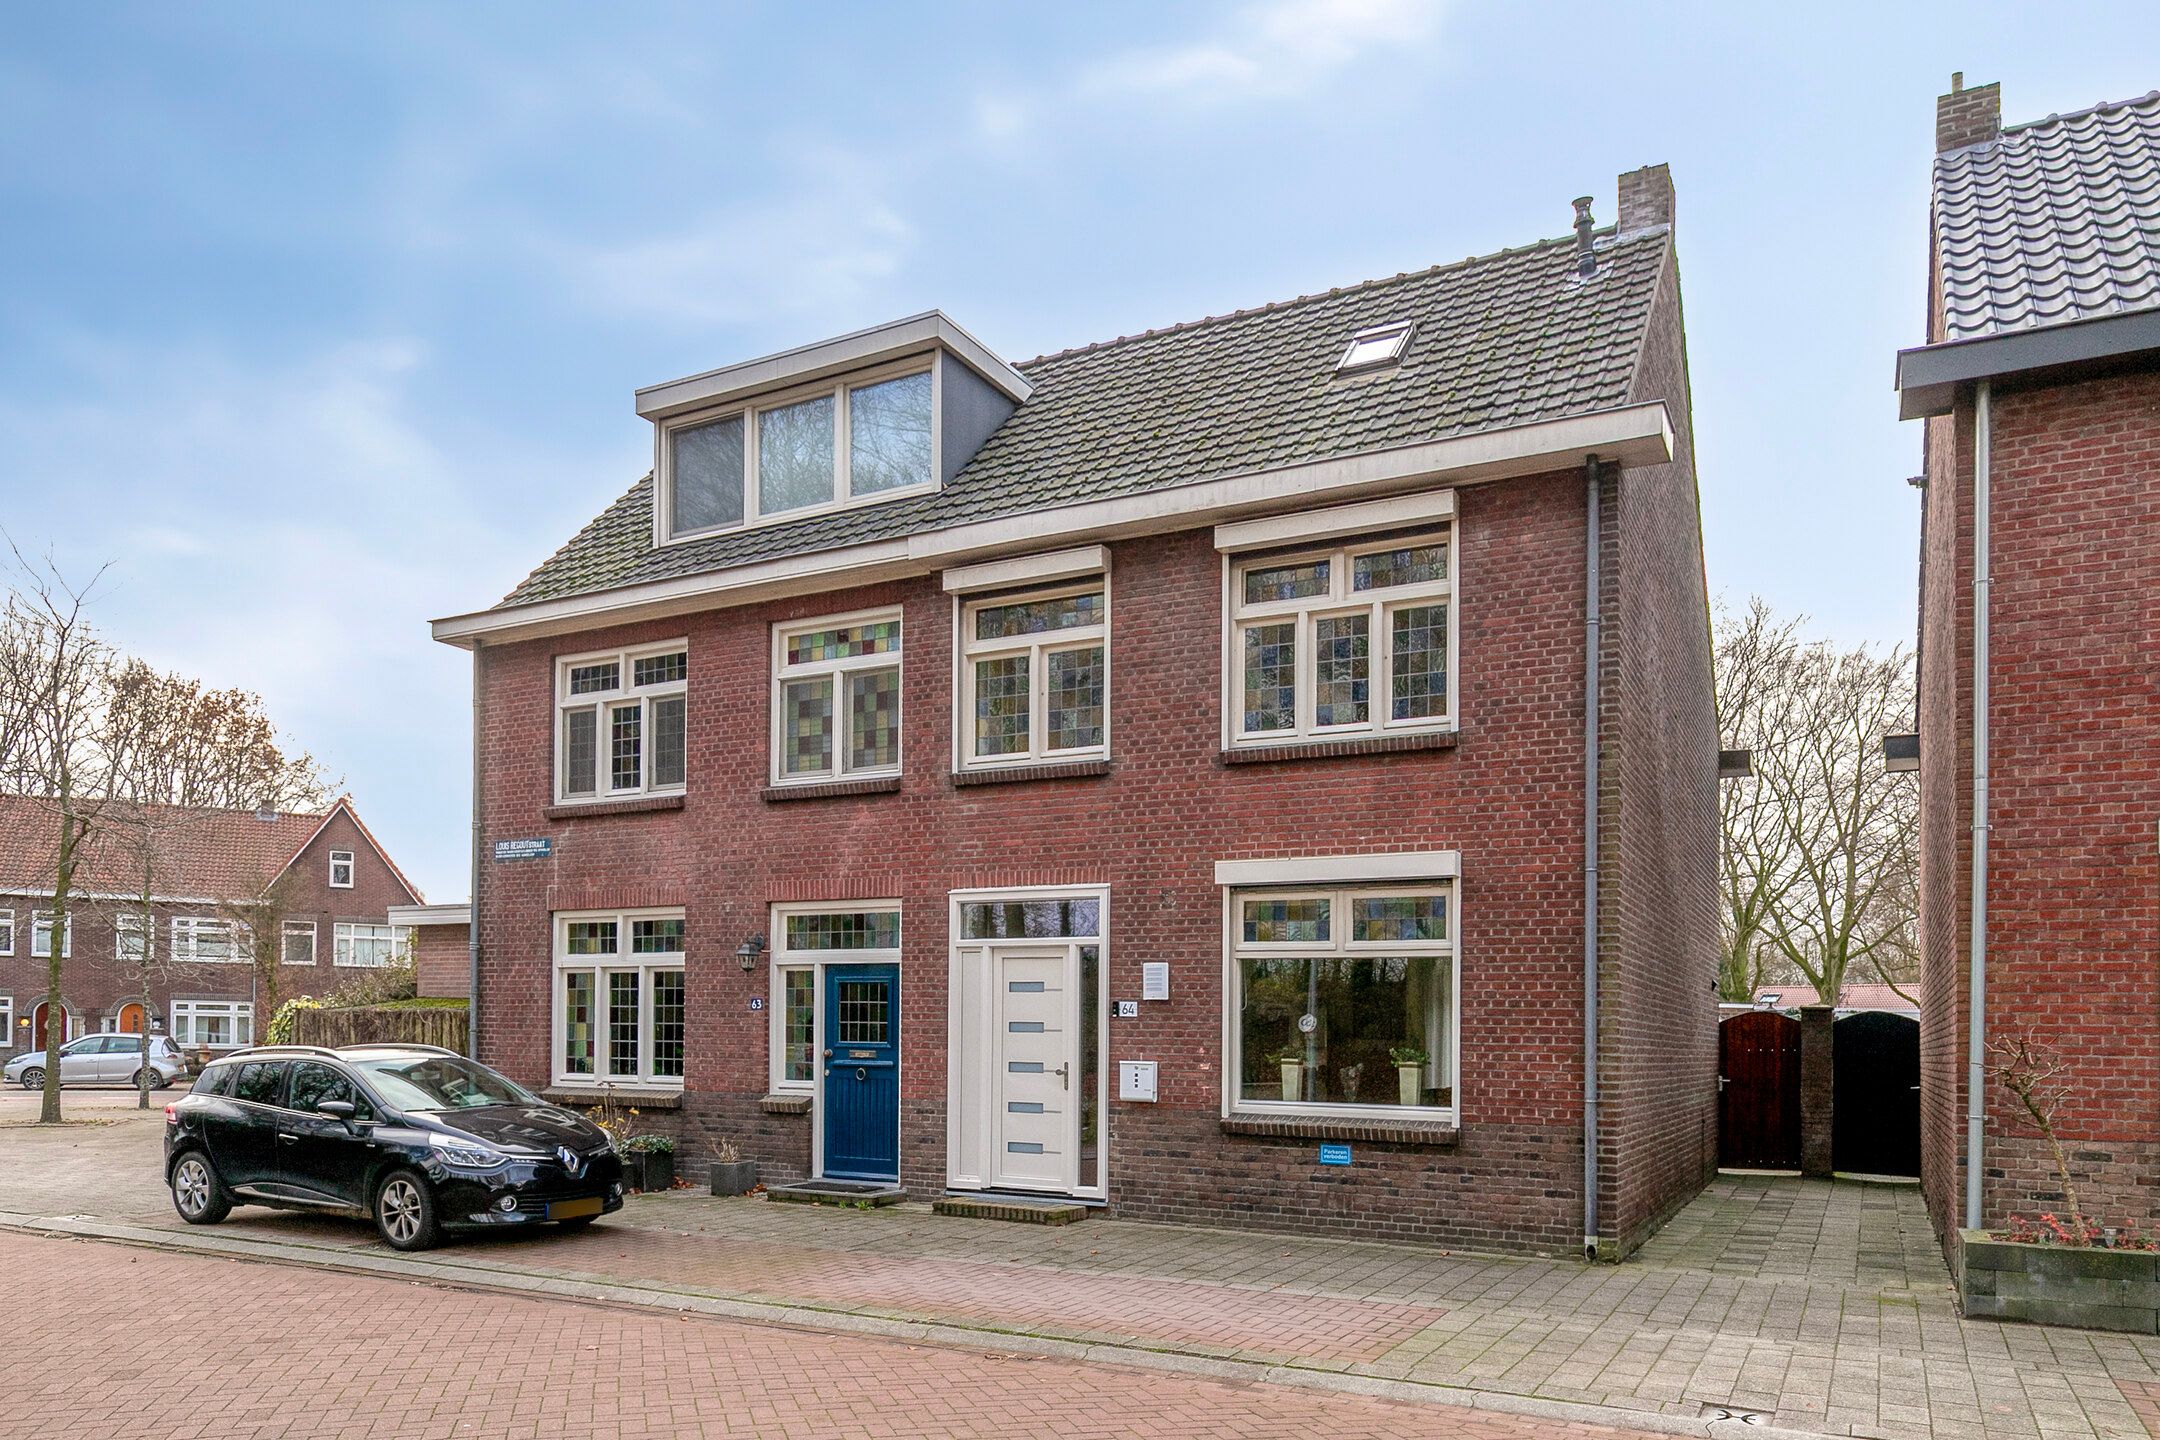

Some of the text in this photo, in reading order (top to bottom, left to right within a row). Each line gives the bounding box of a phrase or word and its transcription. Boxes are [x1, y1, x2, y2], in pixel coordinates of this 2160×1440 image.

[495, 841, 509, 850] LOUIS
[751, 999, 762, 1009] 63
[1122, 1003, 1135, 1015] 64
